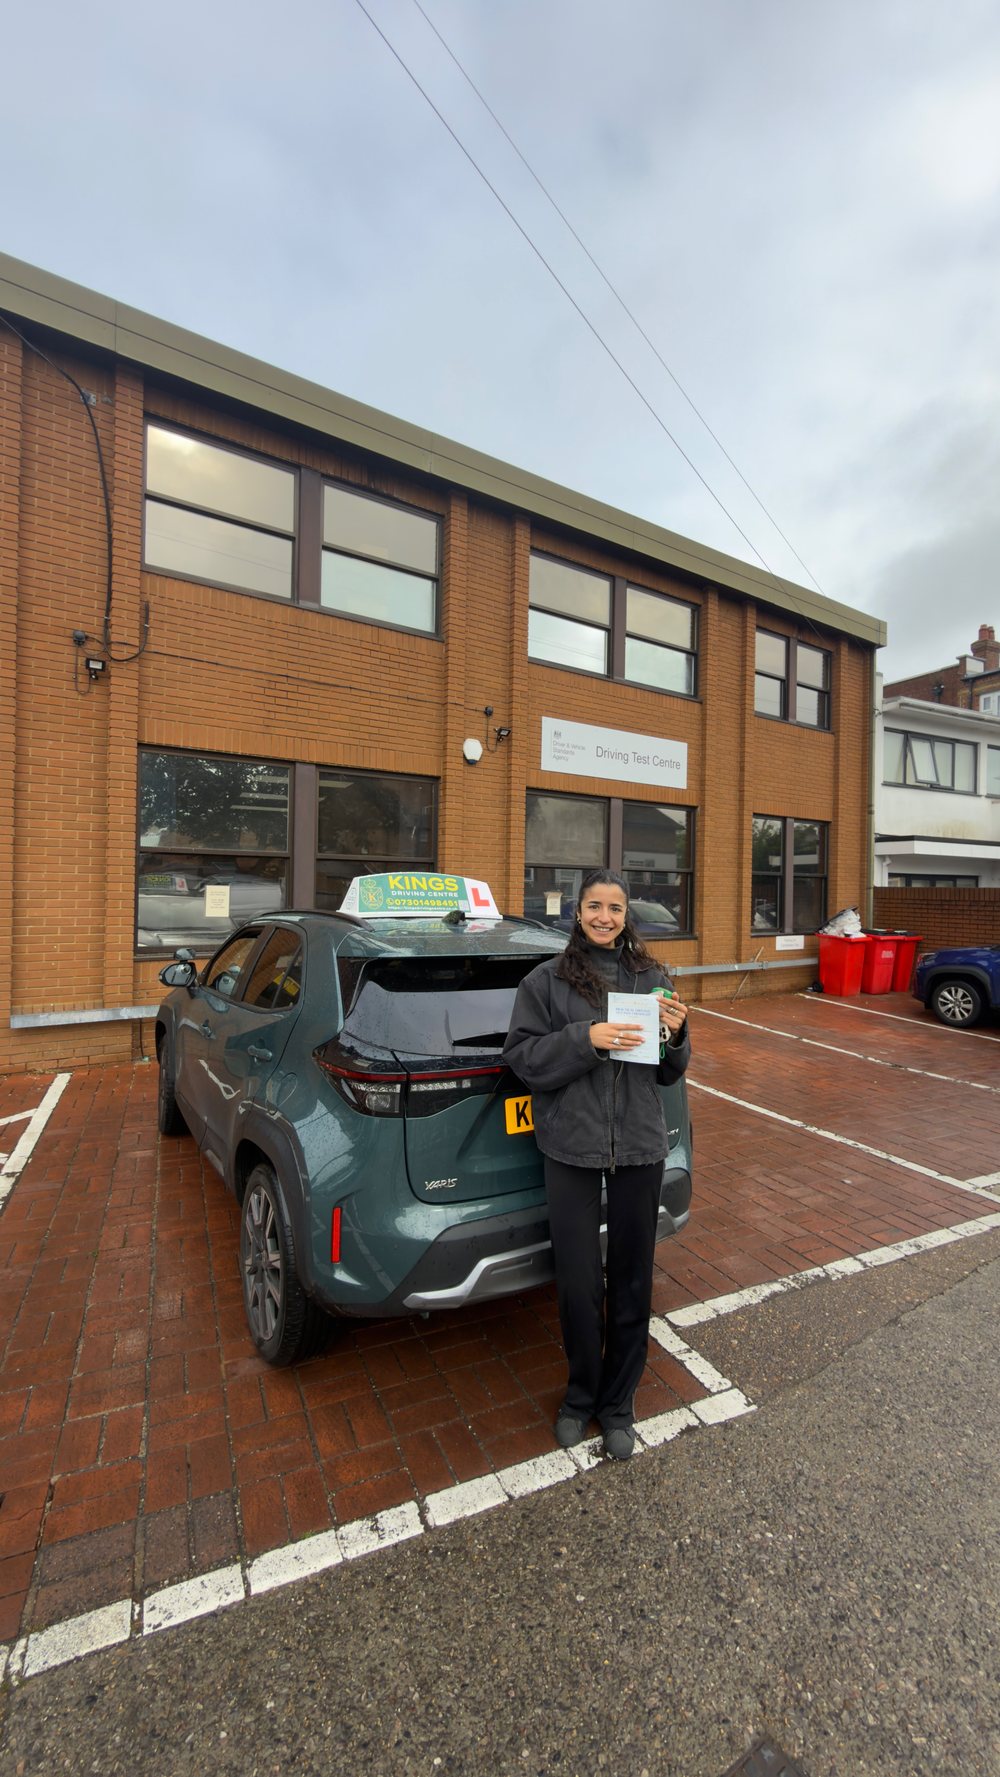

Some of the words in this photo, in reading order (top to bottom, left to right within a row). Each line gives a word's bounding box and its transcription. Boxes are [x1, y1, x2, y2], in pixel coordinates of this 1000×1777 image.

[596, 745, 629, 764] Driving
[632, 751, 650, 765] Test
[652, 755, 681, 770] Centre
[388, 875, 459, 891] KINGS
[471, 887, 490, 907] L
[516, 1101, 534, 1127] K
[425, 1178, 458, 1190] YARIS
